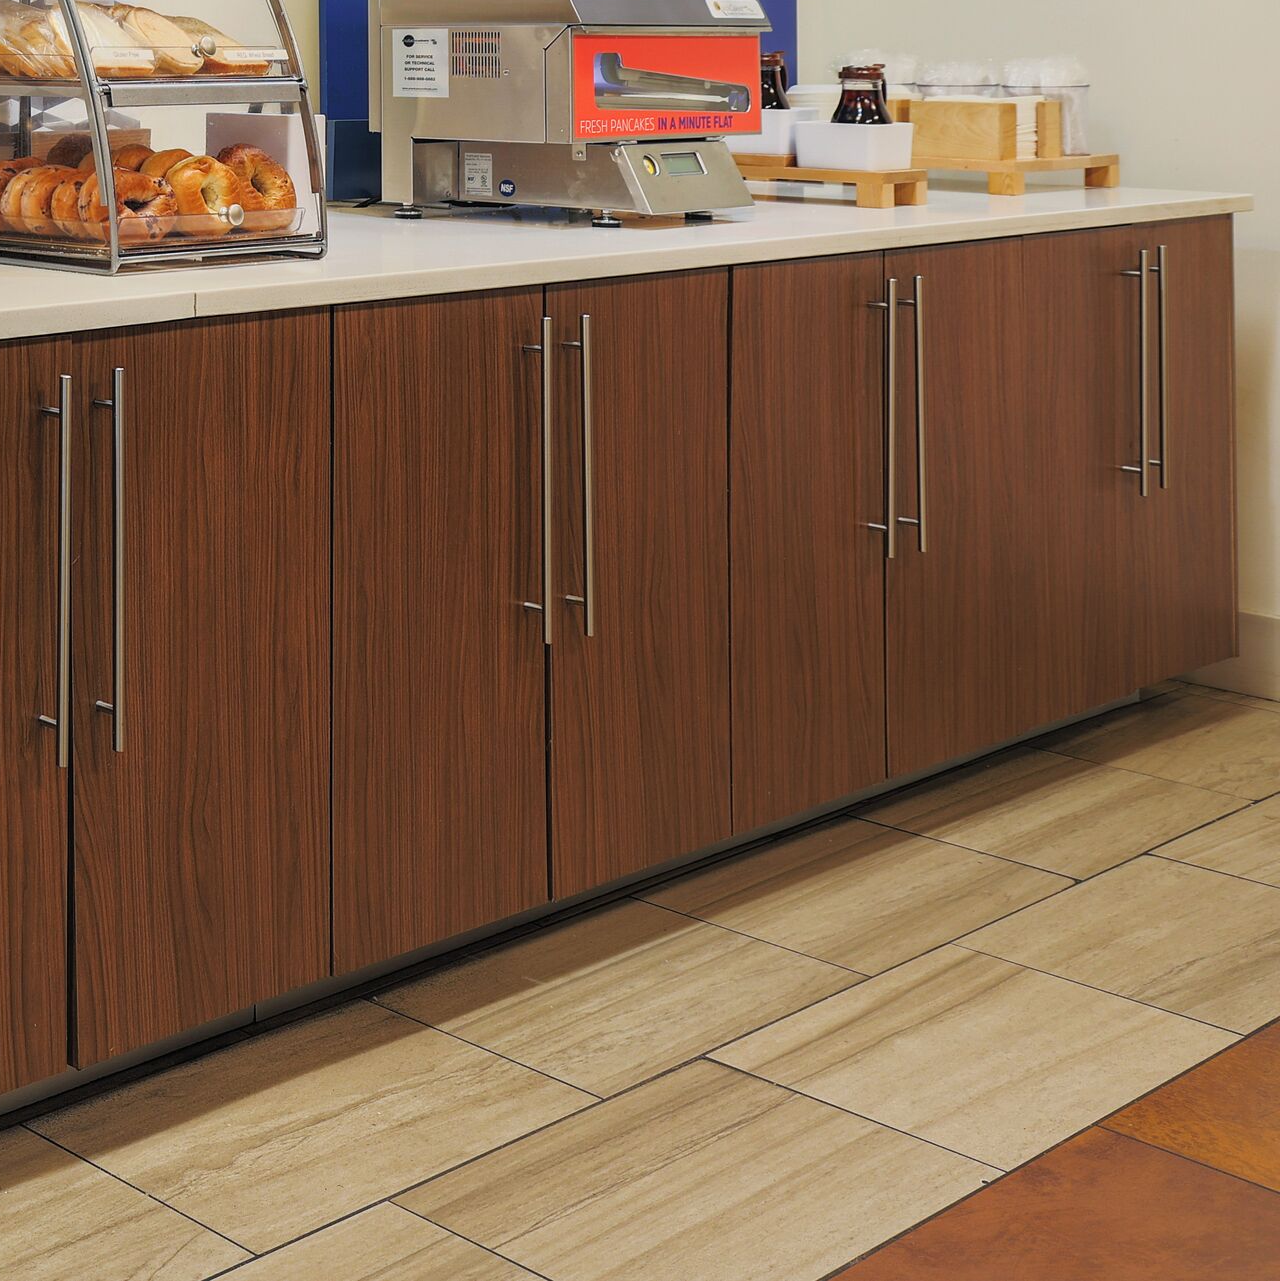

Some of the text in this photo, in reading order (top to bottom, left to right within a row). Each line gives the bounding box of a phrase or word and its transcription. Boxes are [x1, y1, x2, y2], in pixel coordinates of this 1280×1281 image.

[580, 115, 733, 134] FRESH PANCAKES IN A MINUTE FLAT
[500, 183, 514, 193] NSF
